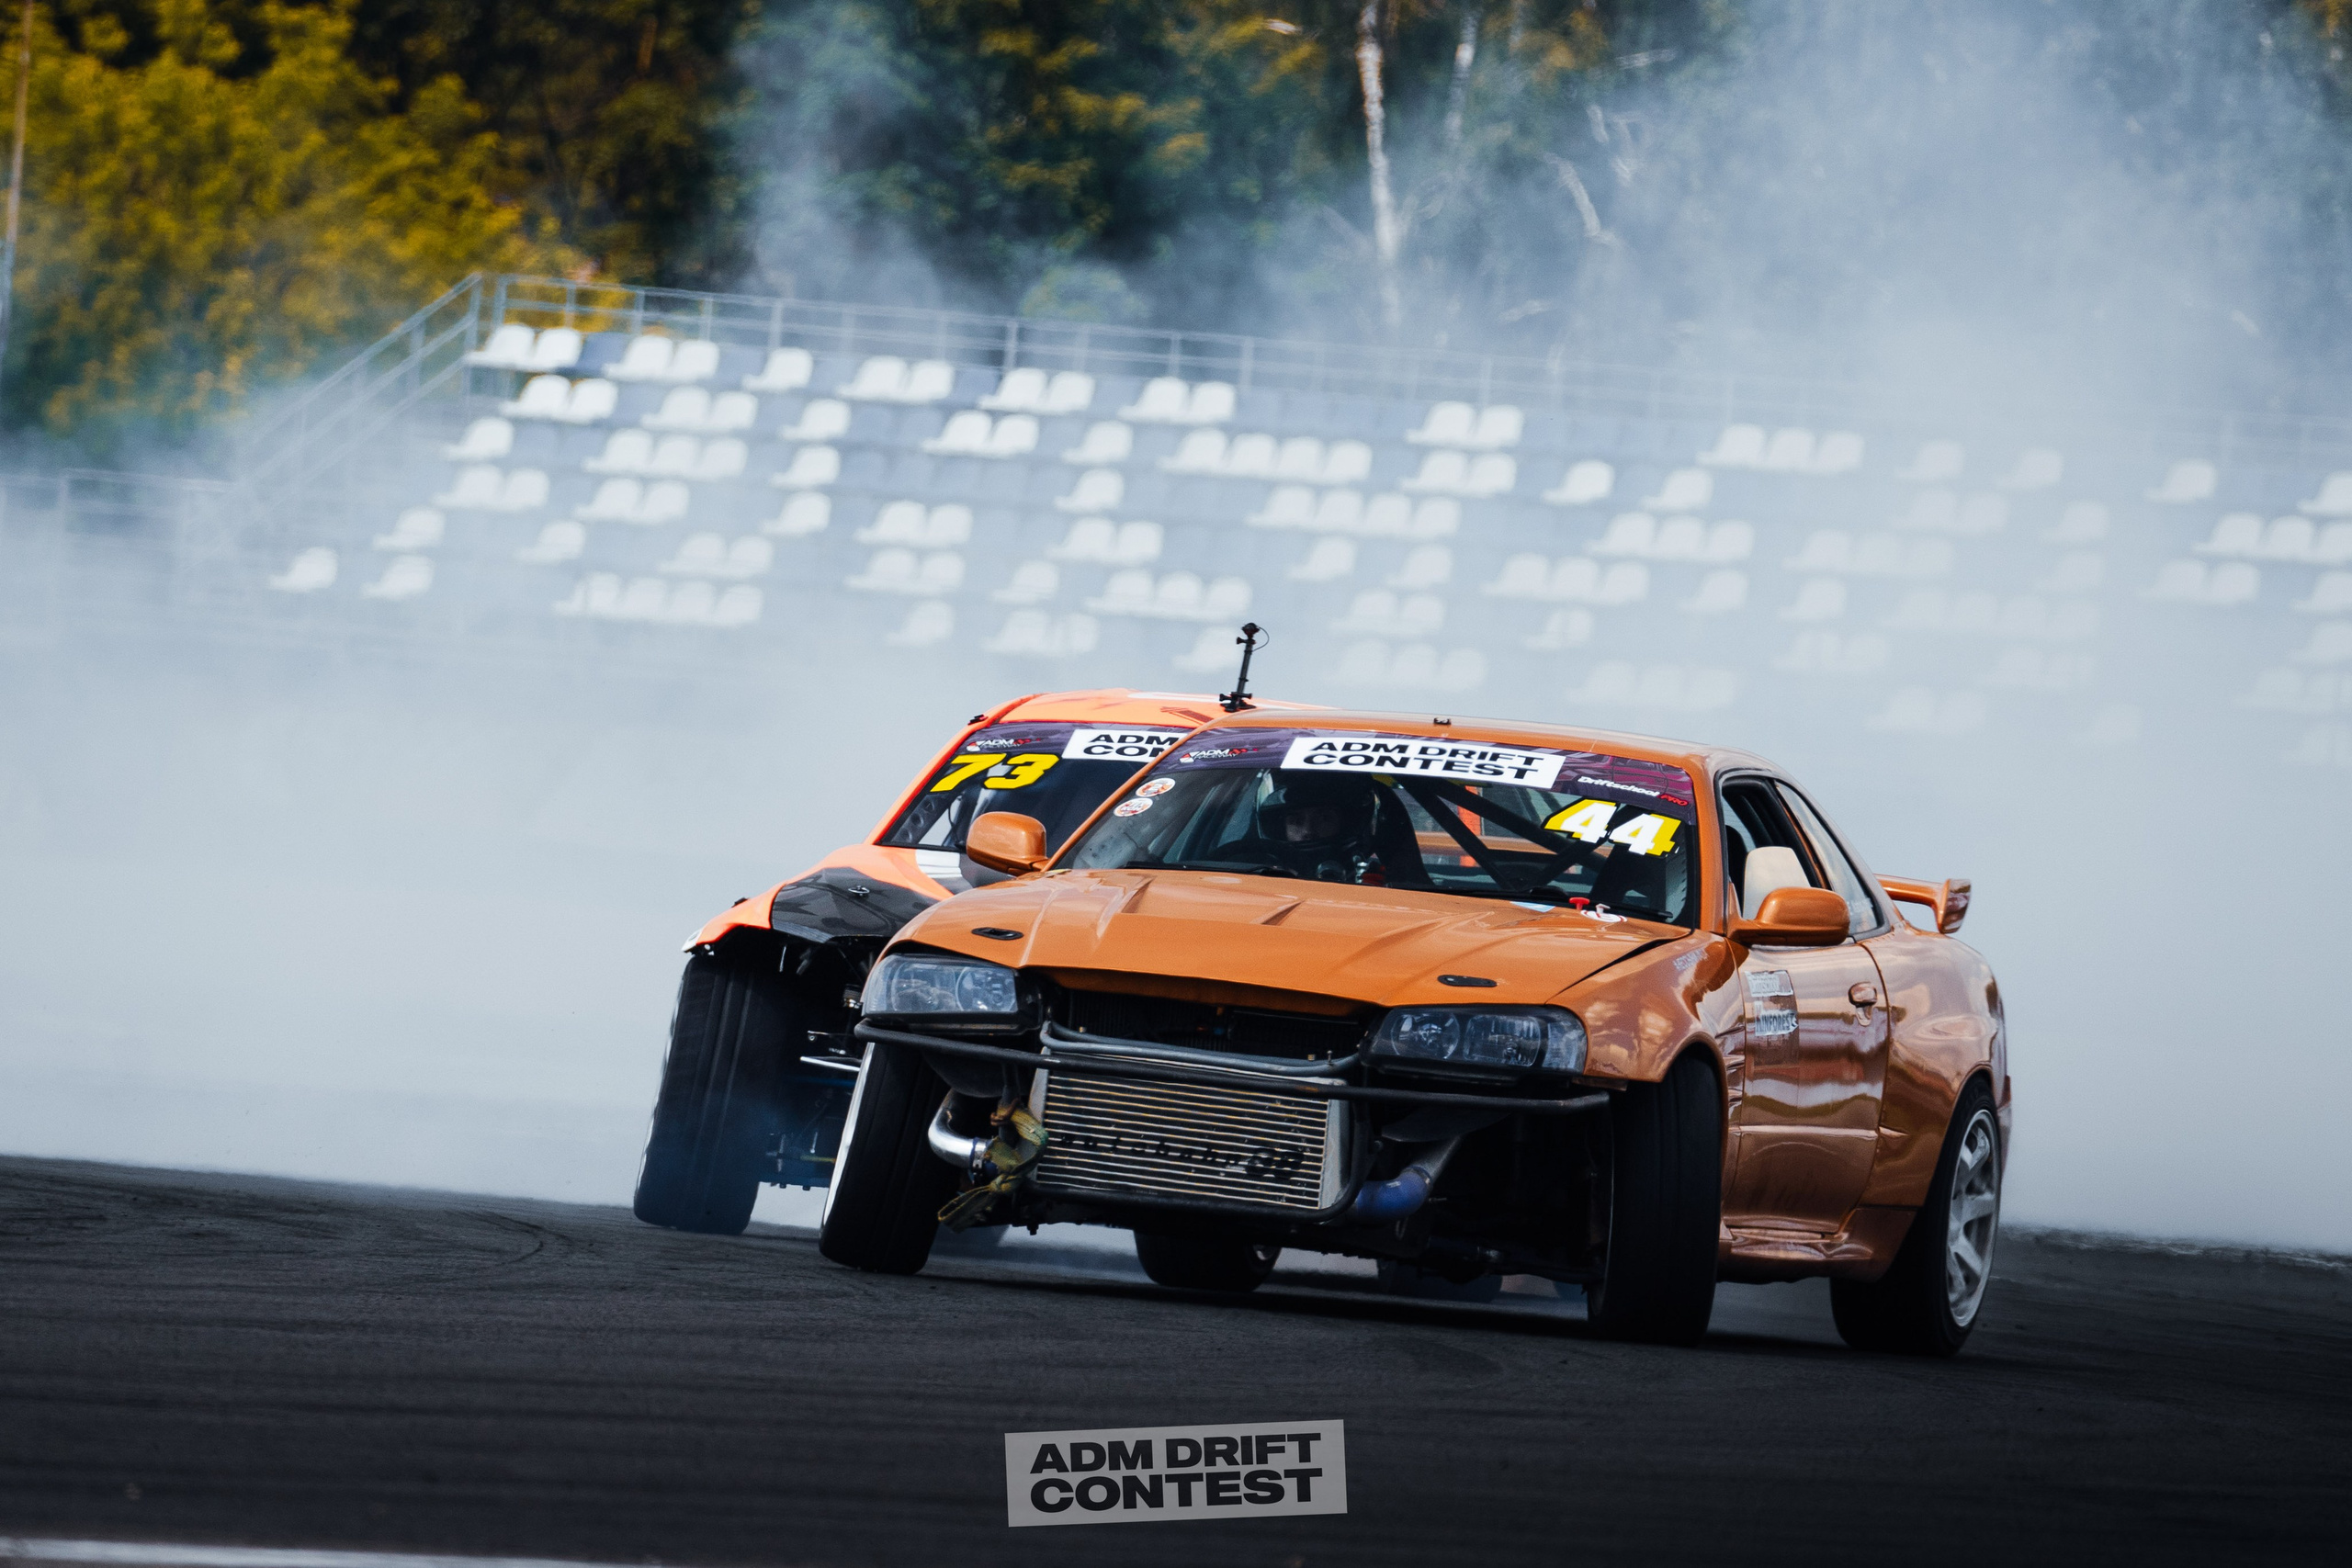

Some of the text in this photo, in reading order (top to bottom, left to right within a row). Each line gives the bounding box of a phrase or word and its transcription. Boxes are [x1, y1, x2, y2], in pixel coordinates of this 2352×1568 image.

[1090, 734, 1180, 745] ADM
[1310, 741, 1544, 767] ADM DRIFT
[930, 753, 1059, 792] 73
[1303, 753, 1539, 780] CONTEST
[1577, 776, 1689, 807] Driftschool PRO
[1544, 798, 1681, 856] 44
